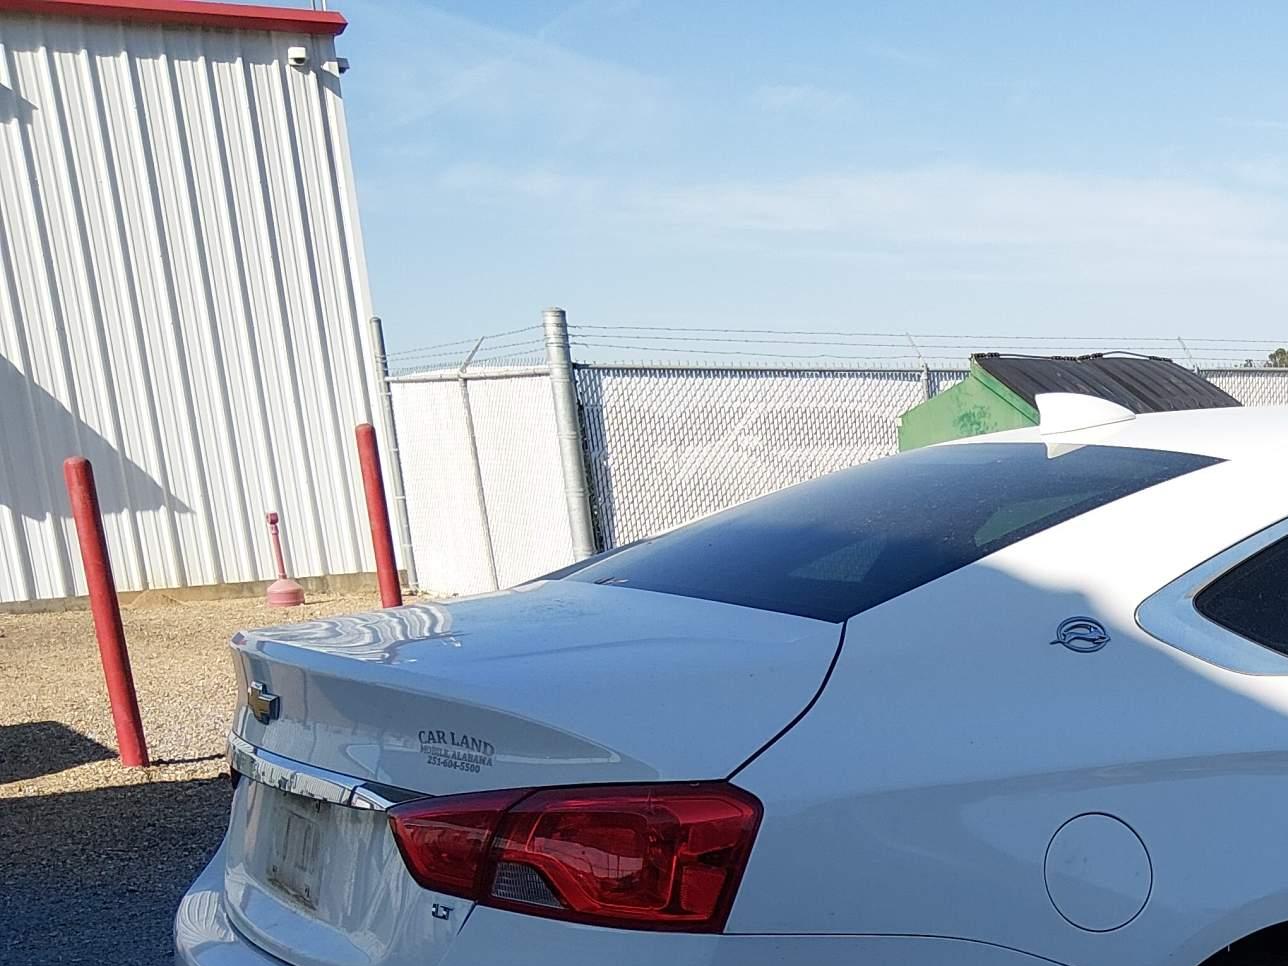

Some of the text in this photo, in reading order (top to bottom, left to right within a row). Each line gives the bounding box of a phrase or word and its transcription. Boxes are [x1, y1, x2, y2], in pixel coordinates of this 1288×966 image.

[418, 730, 495, 757] CAR LAND
[426, 755, 481, 774] 251-604-5500
[451, 750, 493, 767] ALABAMA
[431, 903, 454, 921] LT
